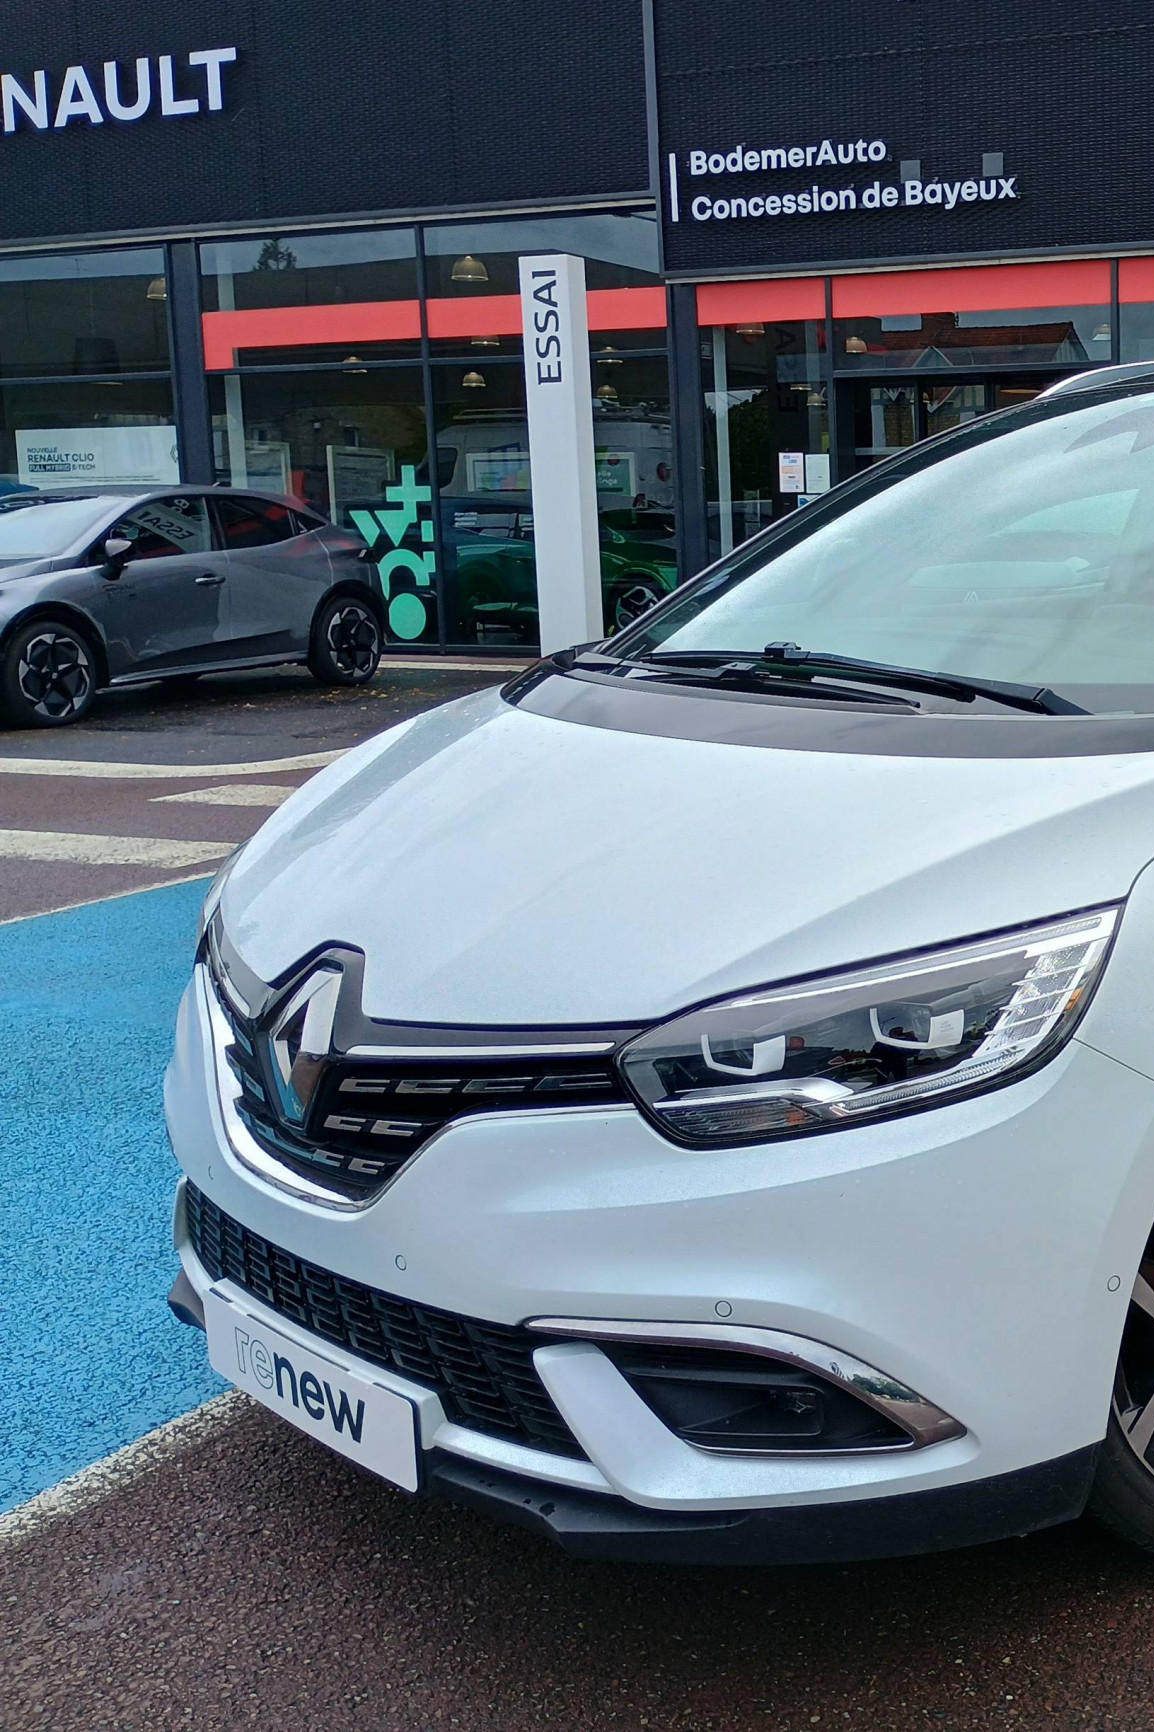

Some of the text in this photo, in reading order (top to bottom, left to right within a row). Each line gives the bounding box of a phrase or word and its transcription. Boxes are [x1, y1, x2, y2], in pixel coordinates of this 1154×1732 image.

[1, 47, 237, 132] NAULT
[690, 139, 887, 176] BodemerAuto
[691, 177, 1017, 221] Concession de Bayeux
[532, 270, 562, 385] ESSAI
[27, 452, 95, 463] RENAULT CLIO
[234, 1326, 366, 1444] renew
